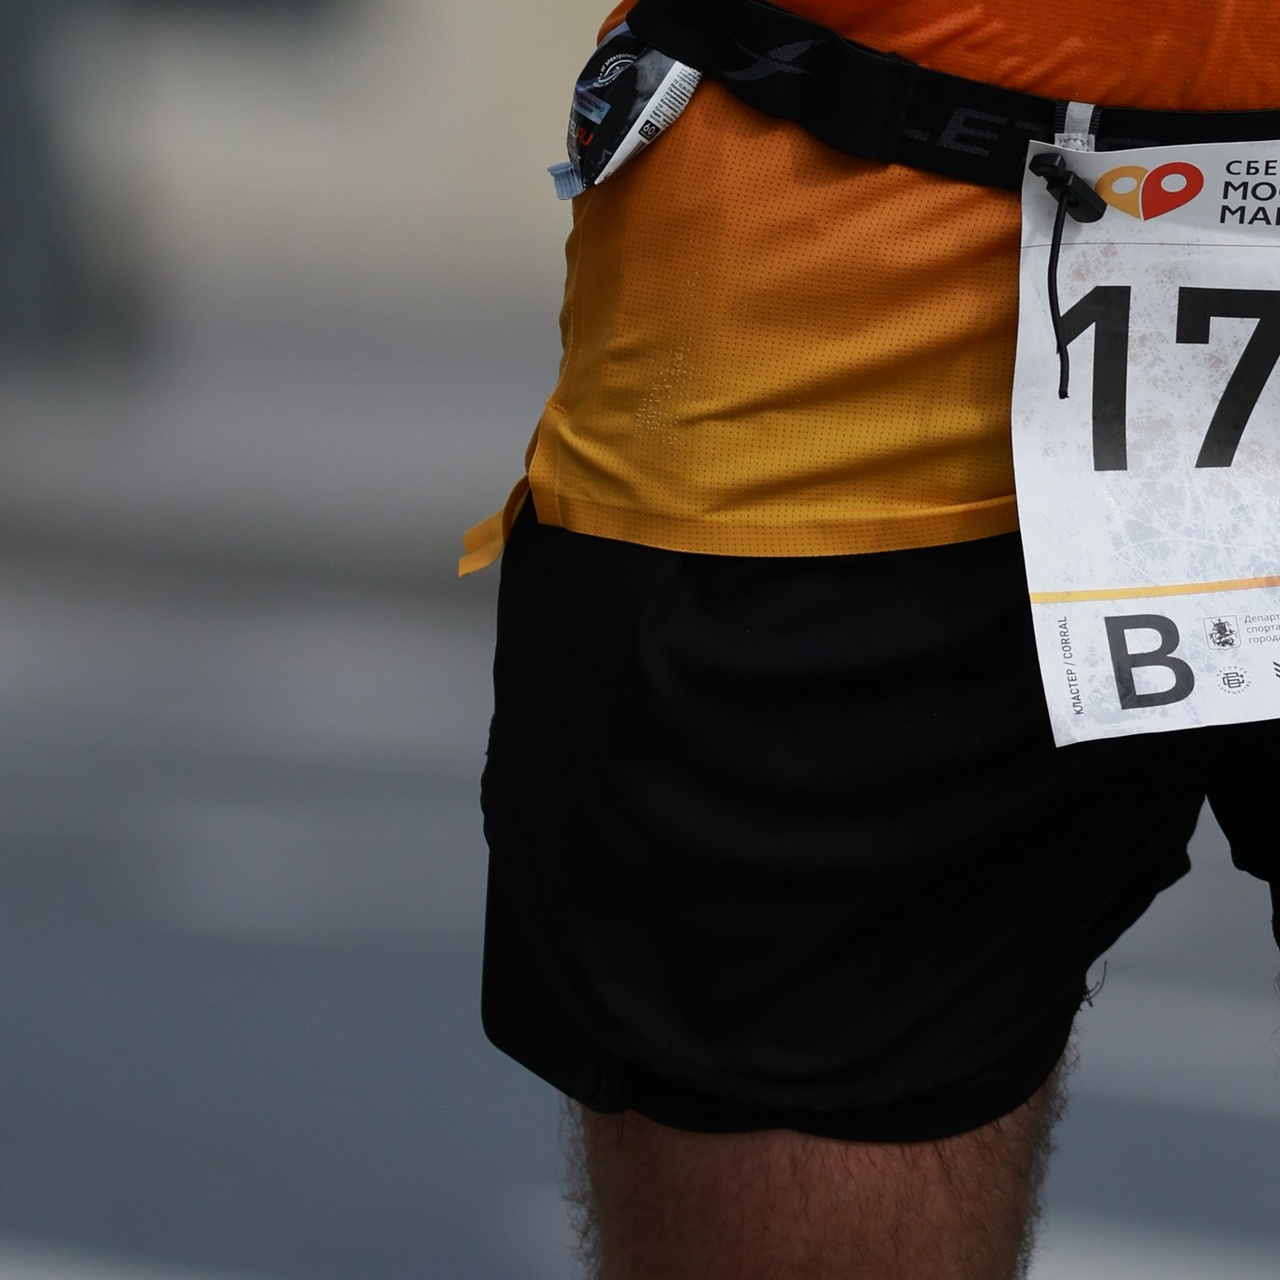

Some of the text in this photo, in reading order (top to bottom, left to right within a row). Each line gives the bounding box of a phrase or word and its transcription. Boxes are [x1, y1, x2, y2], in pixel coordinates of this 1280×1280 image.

[1057, 615, 1073, 660] CORRAL
[1104, 614, 1195, 710] B
[1065, 668, 1084, 715] КЛАСТЕР
